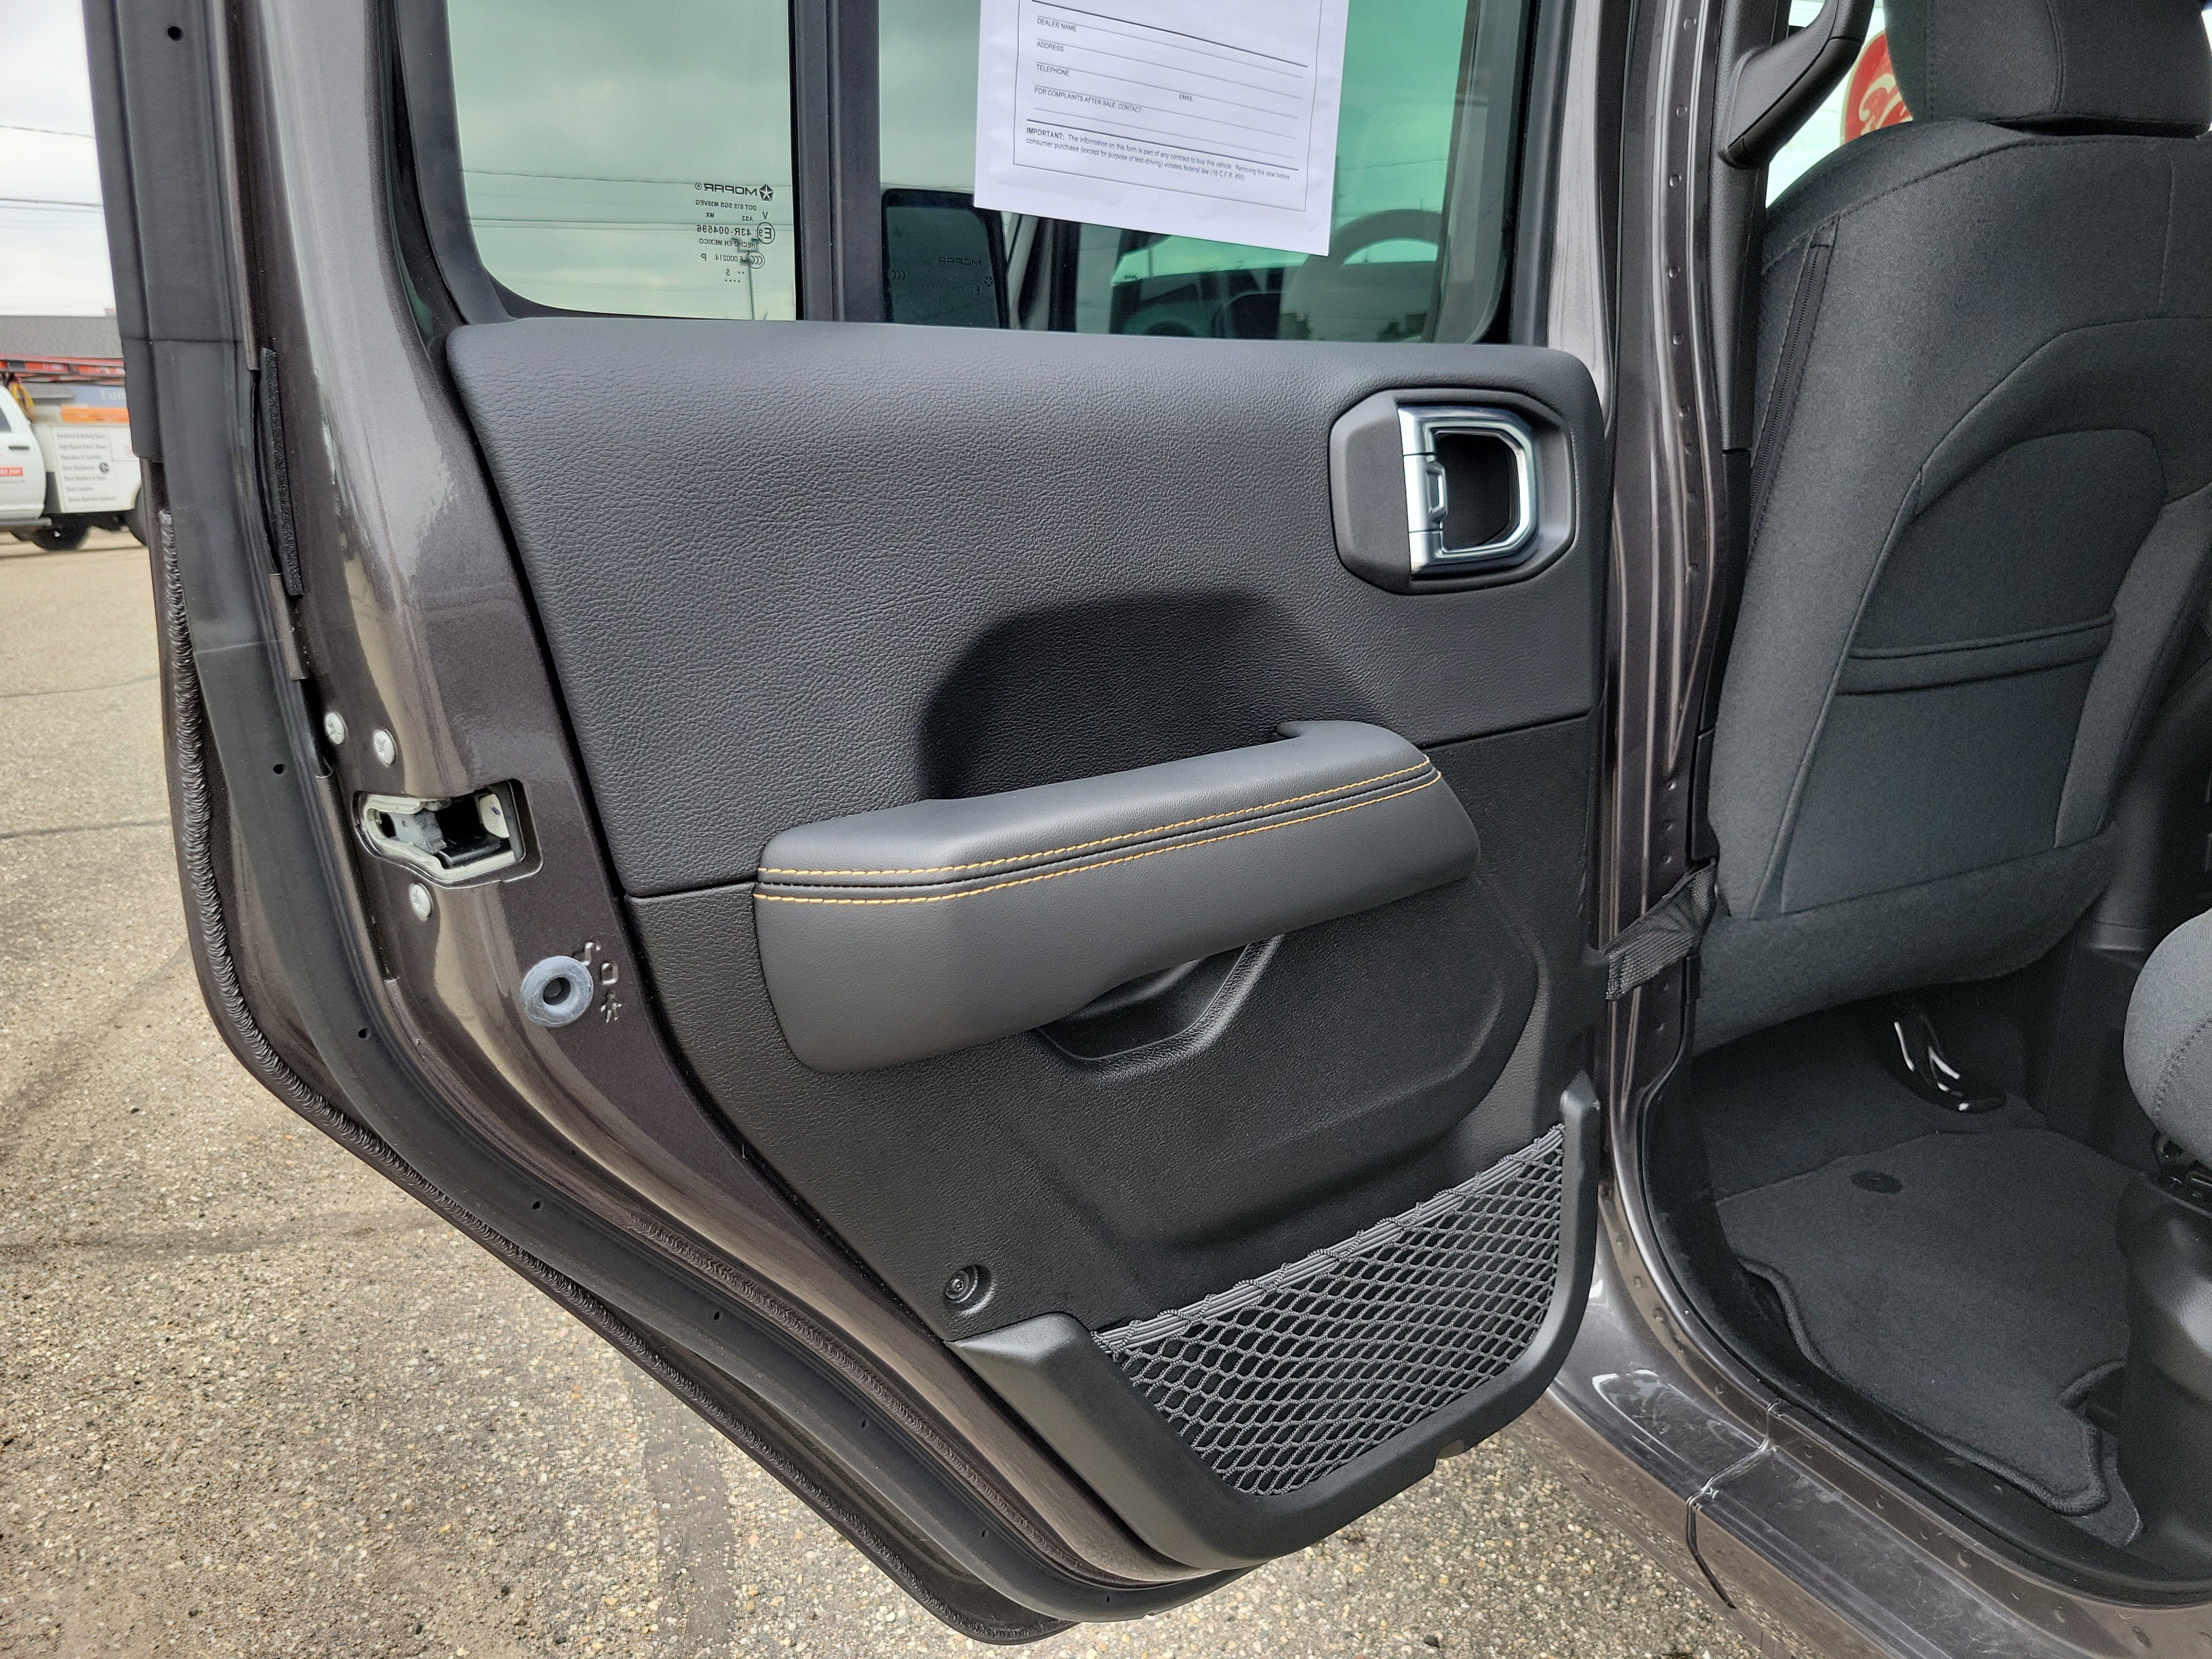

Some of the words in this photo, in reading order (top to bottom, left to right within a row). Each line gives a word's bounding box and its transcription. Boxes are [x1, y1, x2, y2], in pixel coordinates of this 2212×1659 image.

[1037, 18, 1060, 29] DEALER
[1061, 23, 1077, 32] NAME
[1037, 41, 1064, 52] ADDRESS
[1036, 64, 1069, 76] TELEPHONE
[1048, 89, 1084, 101] COMPLAINTS
[1085, 97, 1102, 106] AFTER
[1179, 94, 1193, 102] EMAIL
[1026, 127, 1065, 140] IMPORTANT:
[1069, 134, 1079, 143] The
[1080, 137, 1108, 148] information
[1170, 154, 1189, 162] contract
[1197, 158, 1205, 166] buy
[1235, 165, 1256, 176] Removing
[1265, 170, 1276, 178] label
[1276, 172, 1290, 180] before
[1026, 138, 1053, 148] consumer
[1054, 142, 1079, 153] purchase
[1081, 146, 1099, 156] (except
[1108, 151, 1127, 161] purpose
[1135, 157, 1163, 168] test-driving)
[1164, 162, 1182, 171] violates
[1183, 165, 1200, 173] federal
